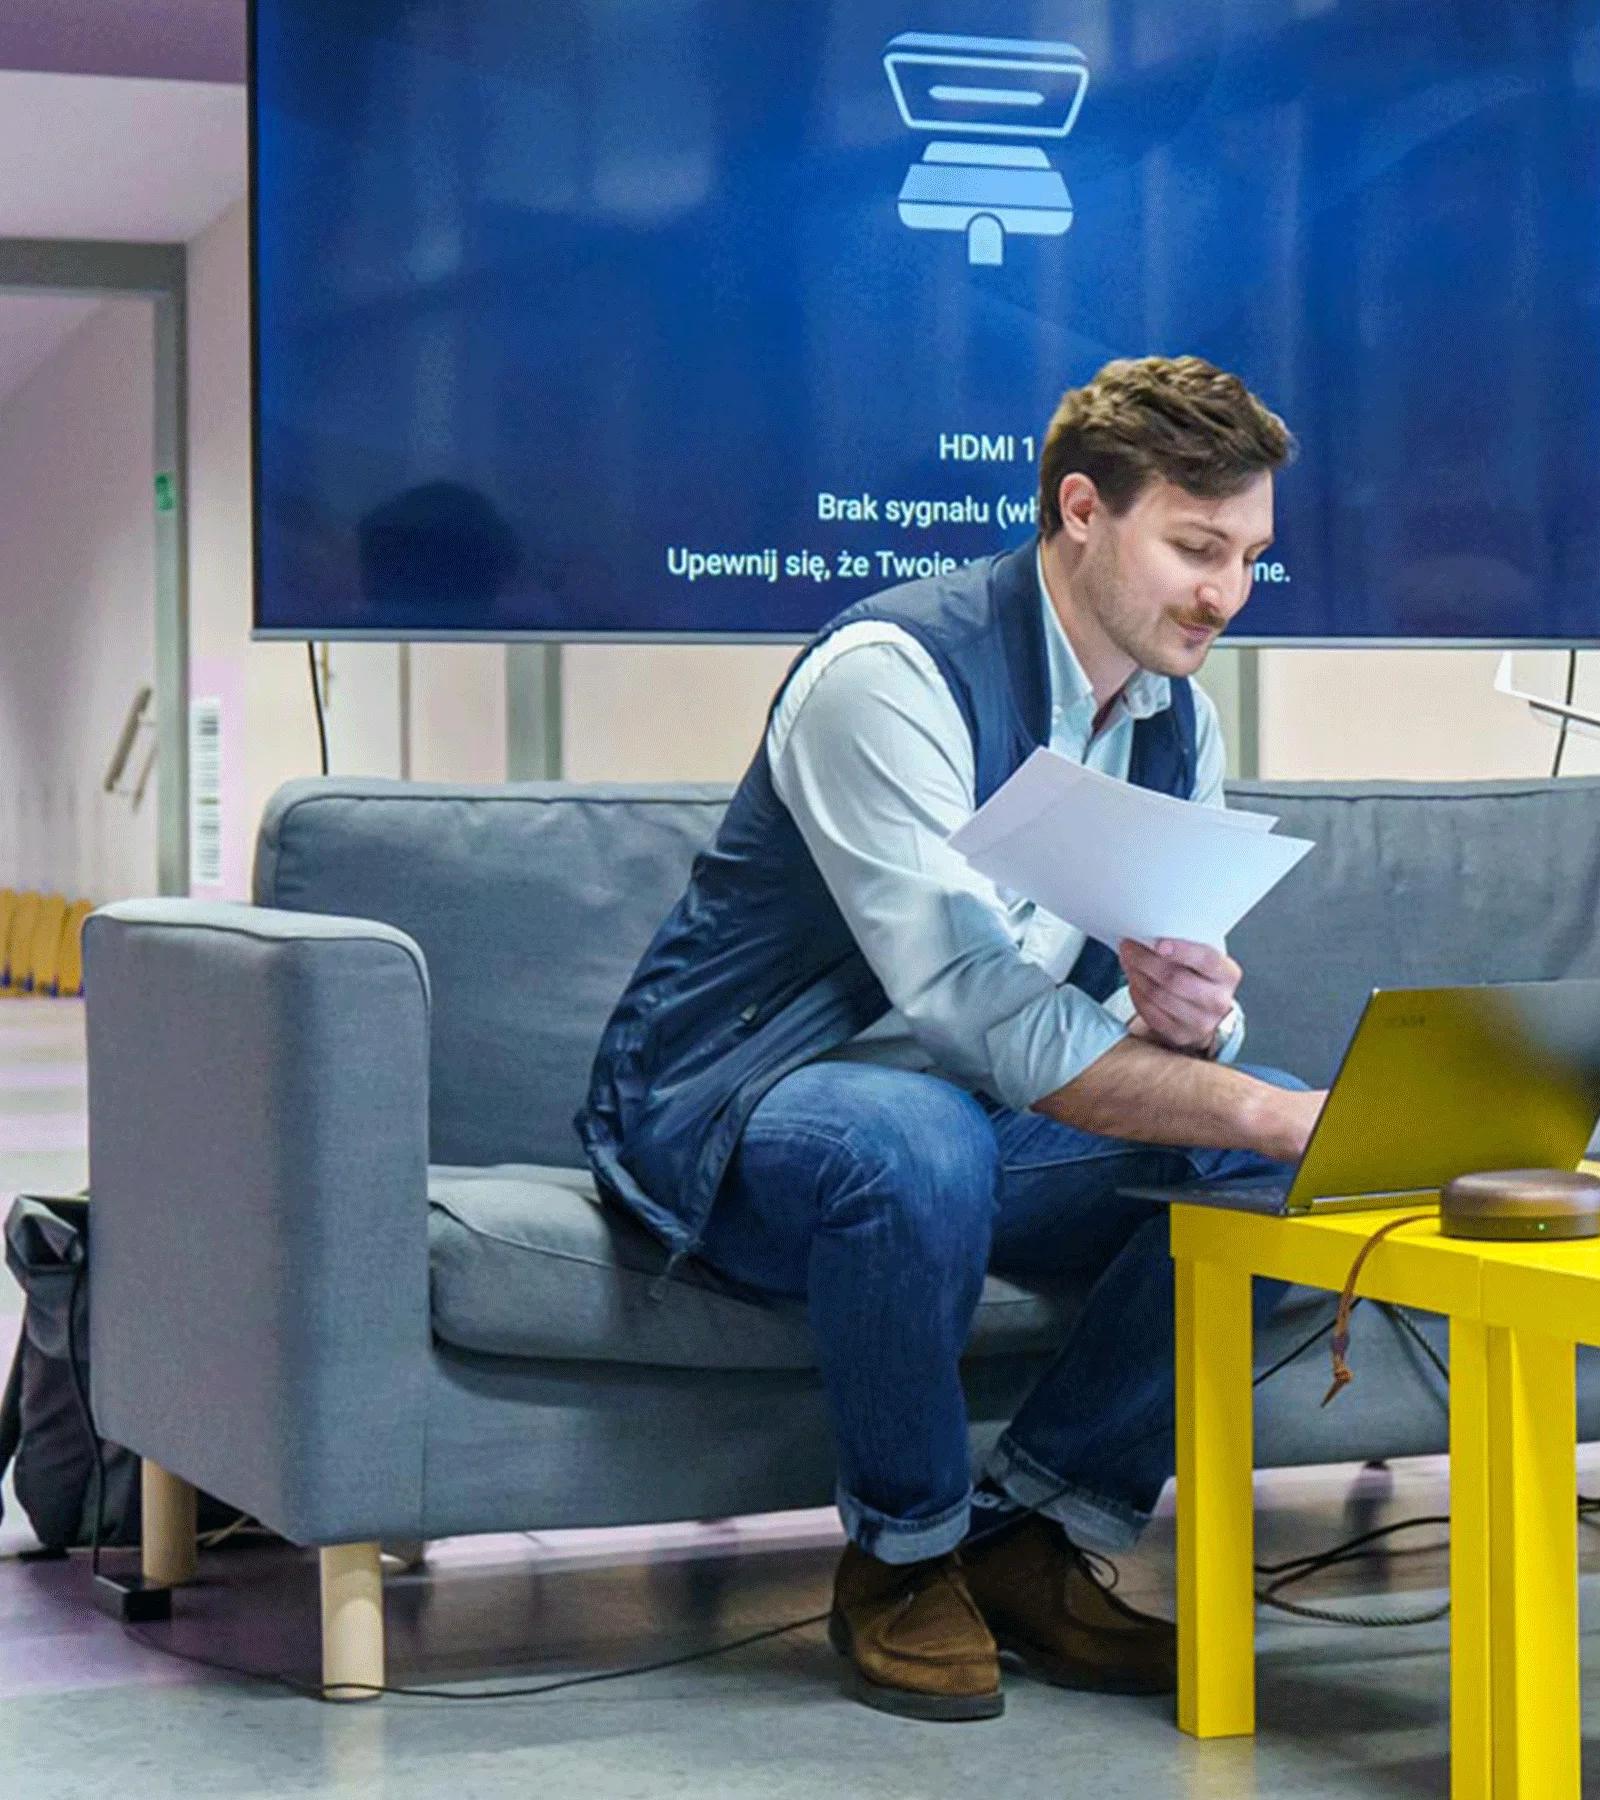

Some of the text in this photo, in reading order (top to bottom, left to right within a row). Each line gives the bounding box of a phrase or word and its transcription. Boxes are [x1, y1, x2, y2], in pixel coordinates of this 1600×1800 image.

[940, 434, 1035, 461] HDMI 1
[818, 493, 1039, 529] Brak sygnału (wł
[667, 548, 777, 581] Upewnij
[785, 549, 831, 581] się,
[837, 551, 869, 576] że
[1253, 561, 1291, 582] ne.
